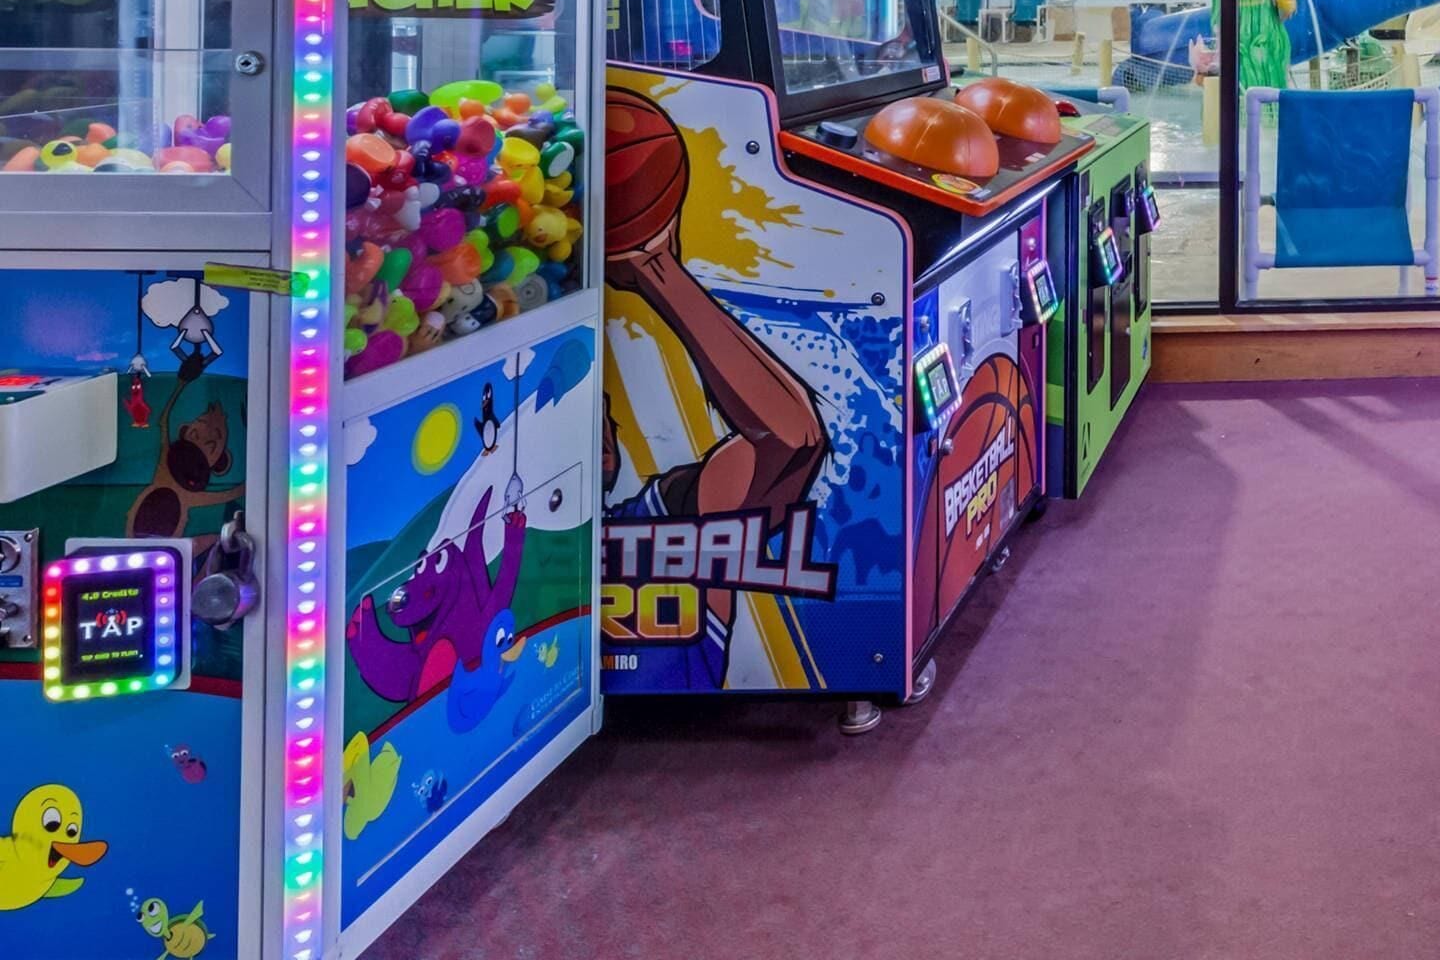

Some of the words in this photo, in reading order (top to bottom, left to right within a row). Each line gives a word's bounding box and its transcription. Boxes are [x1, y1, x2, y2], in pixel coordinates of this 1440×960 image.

[945, 414, 1015, 537] BASKETBALL
[967, 469, 998, 536] PRO
[602, 509, 831, 593] TBALL
[79, 615, 143, 640] TAP
[601, 582, 700, 639] RO
[600, 654, 638, 670] MIRO
